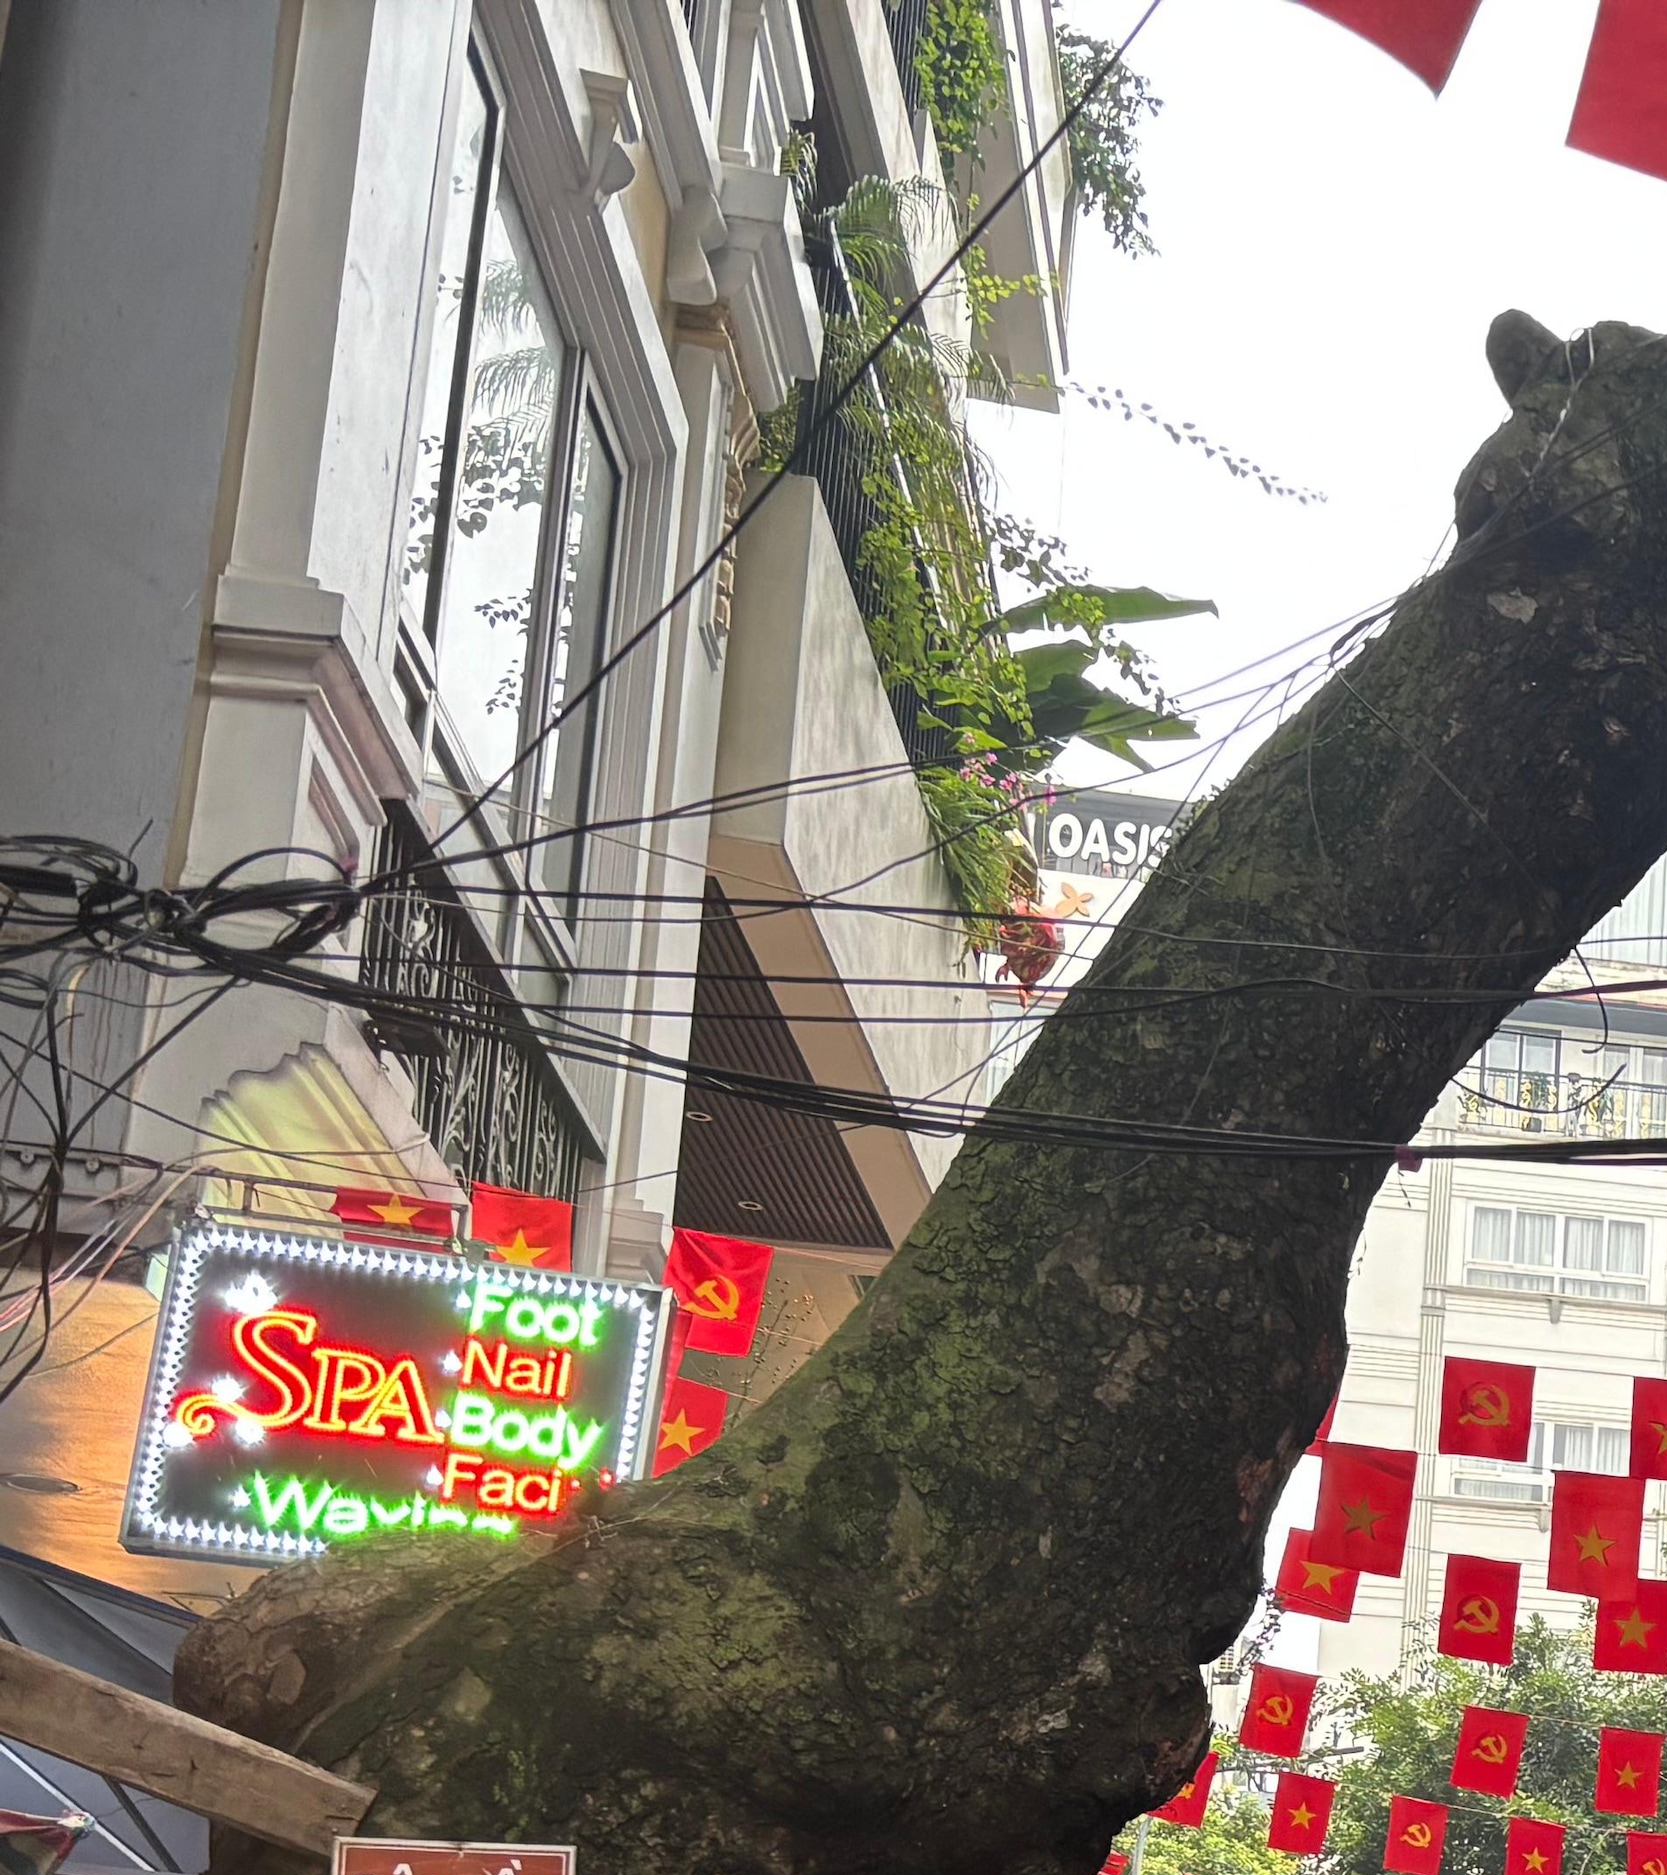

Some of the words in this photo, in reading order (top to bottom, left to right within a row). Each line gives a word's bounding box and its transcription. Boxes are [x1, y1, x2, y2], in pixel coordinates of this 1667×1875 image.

[1048, 813, 1174, 868] OASIS
[467, 1281, 604, 1347] Foot
[459, 1340, 572, 1399] Nail
[450, 1394, 601, 1470] Body
[439, 1453, 590, 1514] Faci
